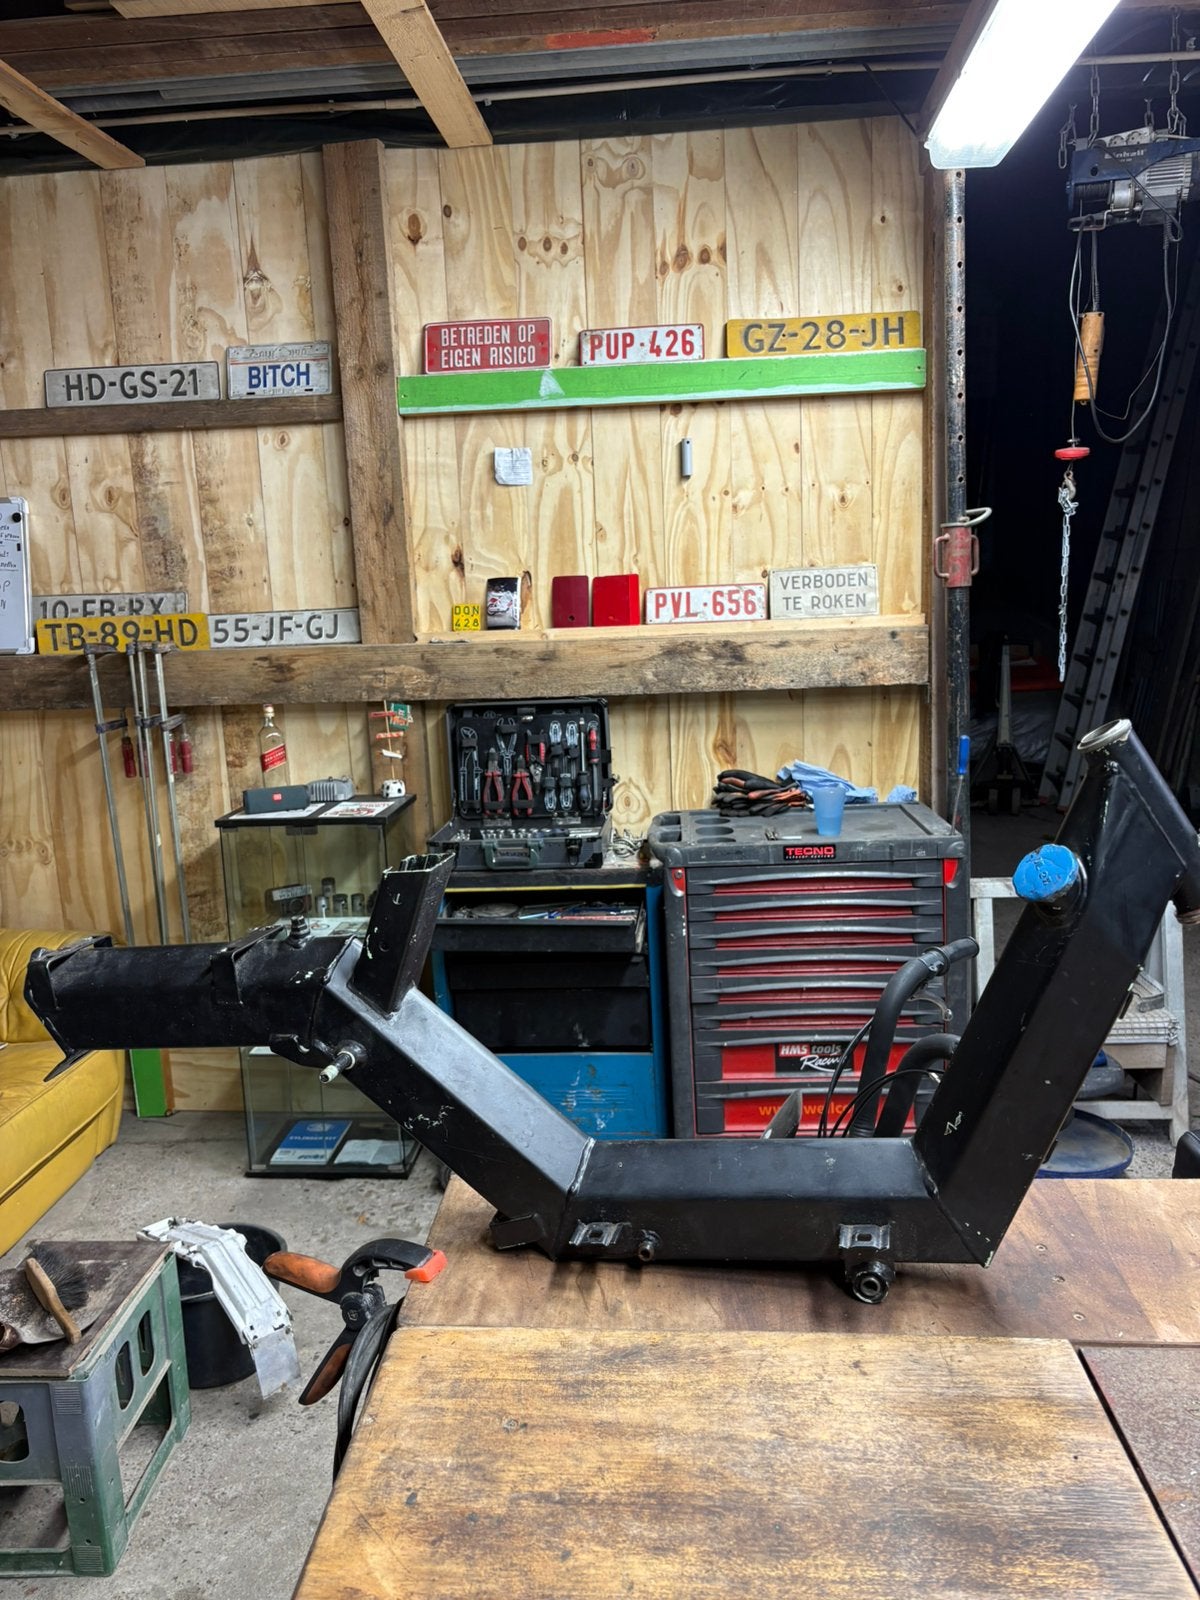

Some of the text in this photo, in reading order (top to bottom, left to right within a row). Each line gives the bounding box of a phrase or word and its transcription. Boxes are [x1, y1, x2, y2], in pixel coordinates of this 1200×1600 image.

[441, 324, 536, 347] BETREDEN OP
[743, 316, 905, 354] GZ-28-JH
[441, 345, 536, 369] EIGEN RISICO
[65, 368, 199, 401] HD-GS-21
[248, 362, 310, 390] BITCH
[779, 571, 869, 590] VERBODEN
[782, 593, 867, 611] TE ROKEN
[44, 618, 198, 651] TB-89-HD
[213, 613, 338, 644] 55-JF-GJ
[785, 846, 834, 856] TECNO
[780, 1043, 842, 1055] HMS tools
